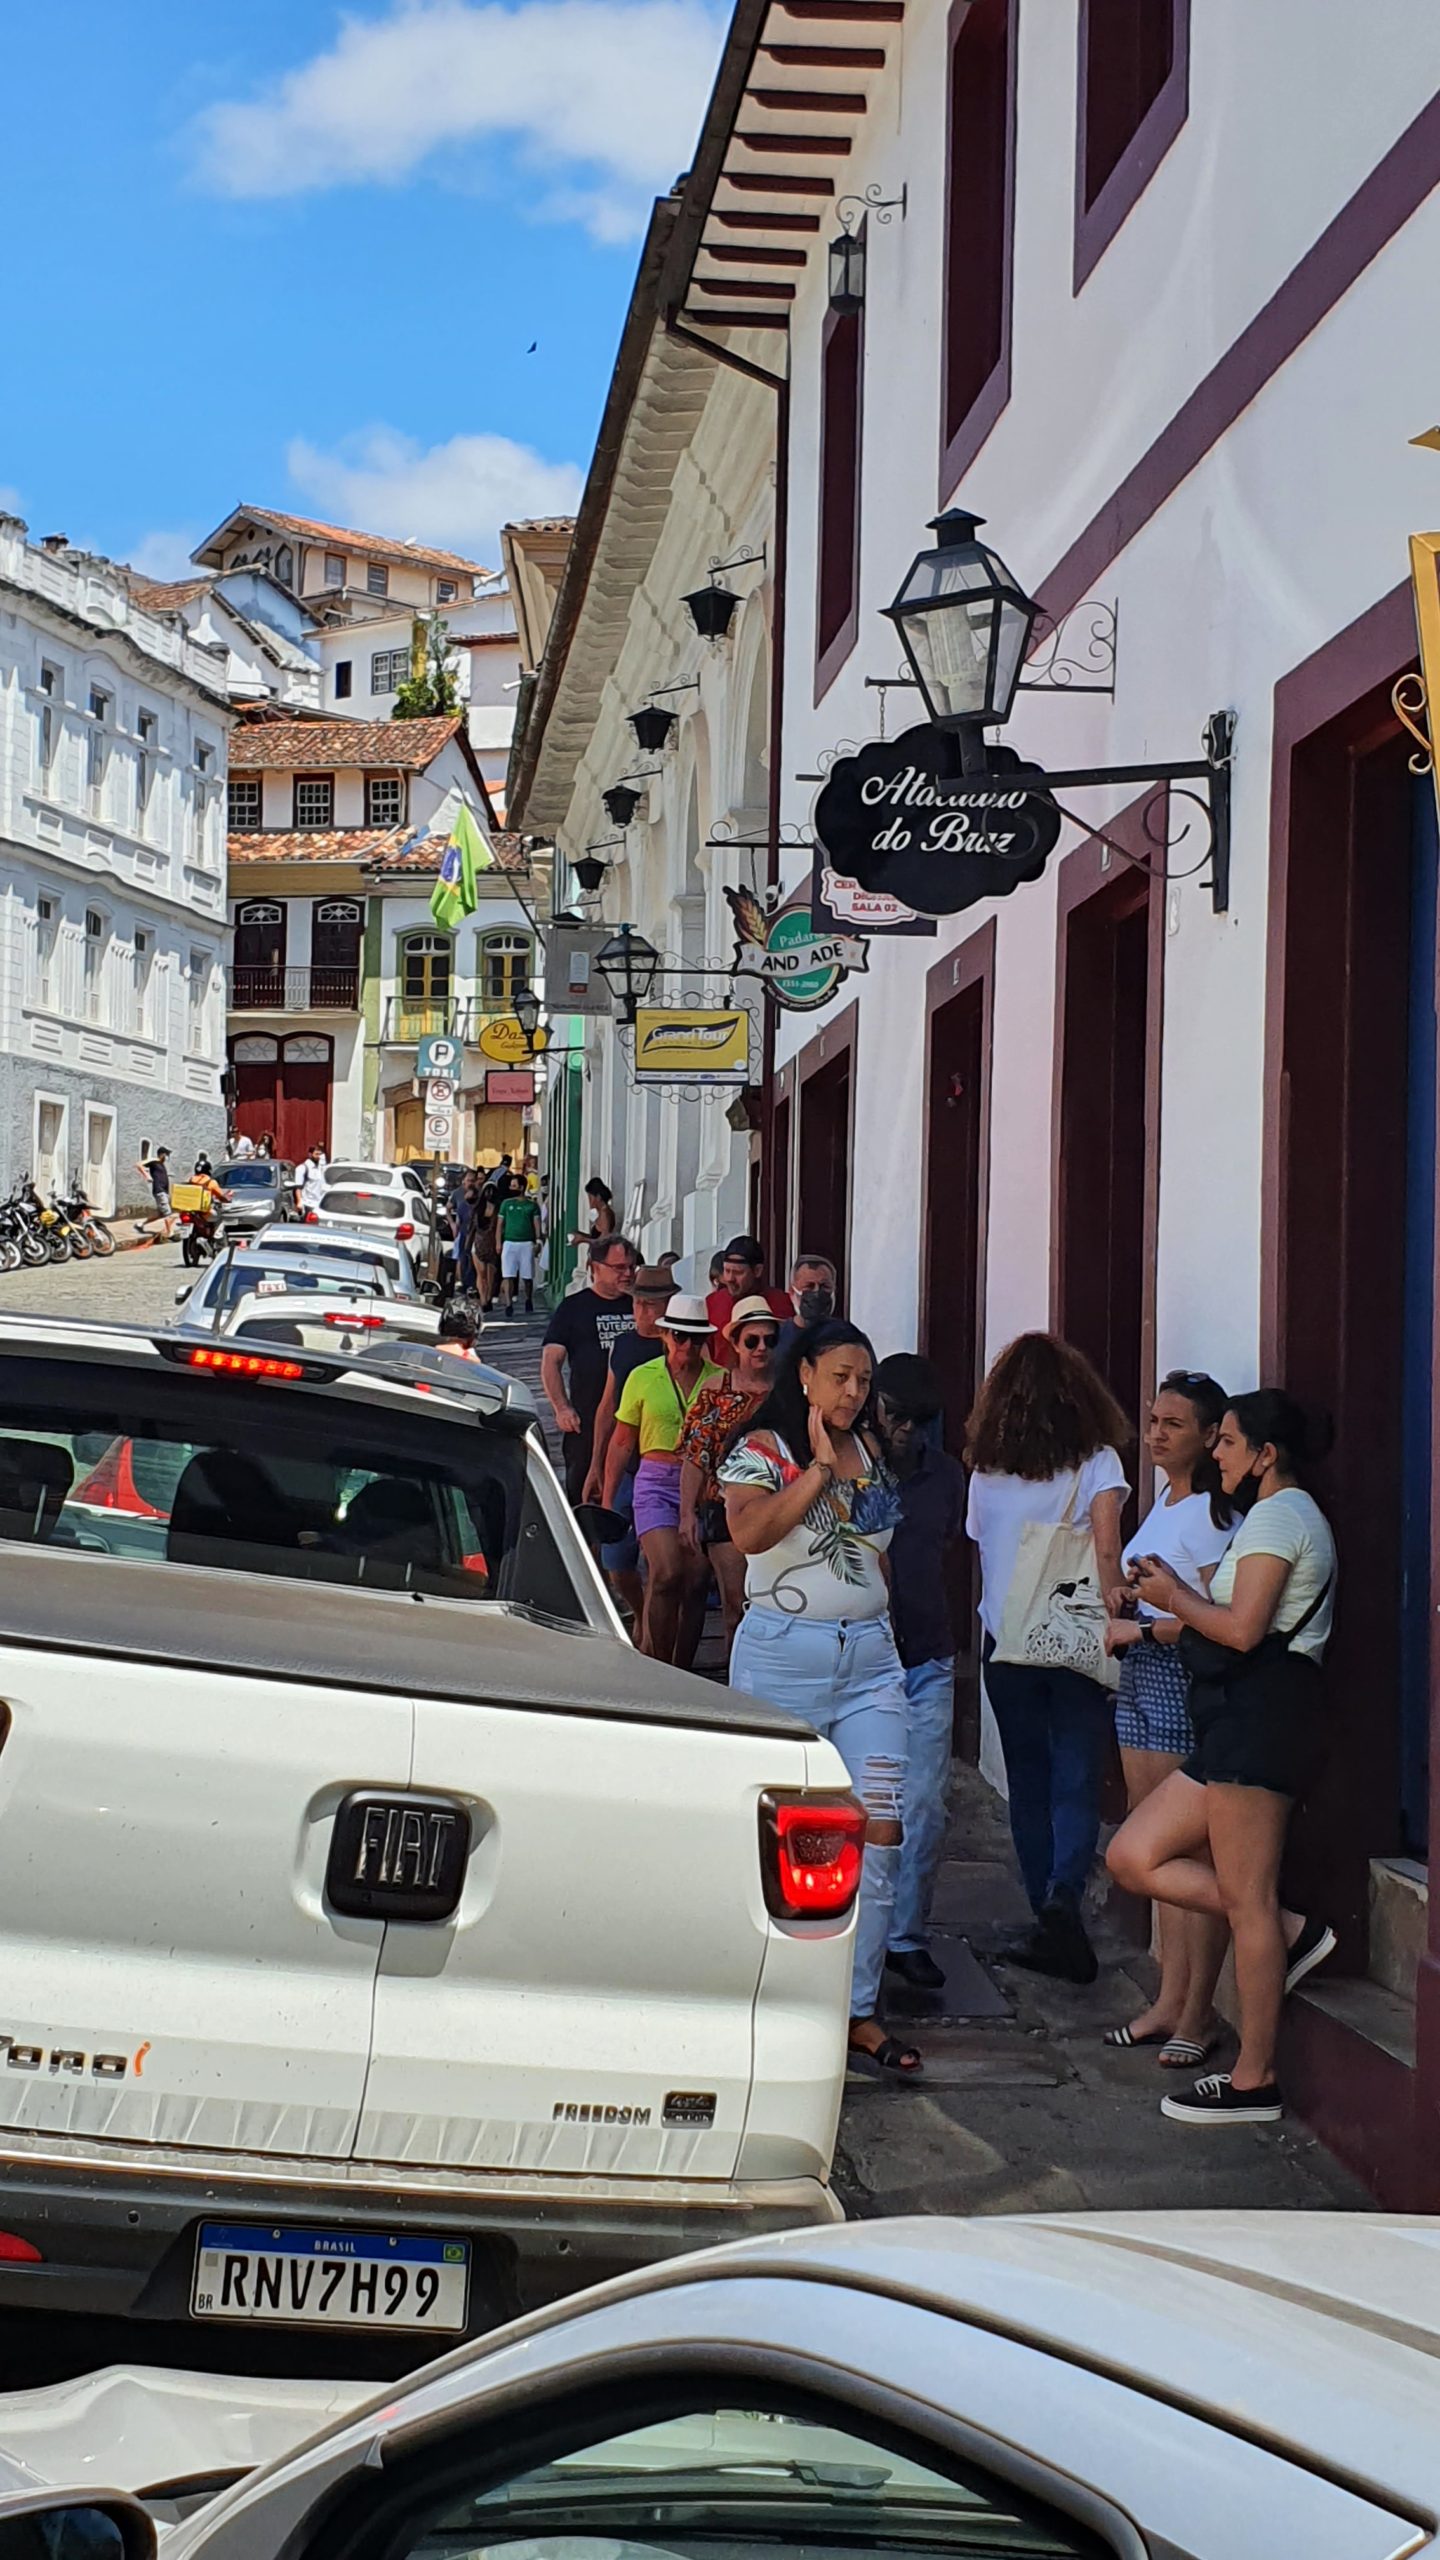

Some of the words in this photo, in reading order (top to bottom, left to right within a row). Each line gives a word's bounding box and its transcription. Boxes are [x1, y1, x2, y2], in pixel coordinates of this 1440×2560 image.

[871, 817, 912, 851] do
[920, 812, 1017, 854] Braz
[852, 902, 882, 912] SALA
[884, 903, 898, 913] 02
[434, 1043, 449, 1061] P
[423, 1066, 455, 1078] TAXI
[433, 1119, 443, 1132] E
[353, 1806, 456, 1887] FIAT
[551, 2102, 652, 2127] FREEDOM
[313, 2239, 357, 2254] BRASIL
[220, 2254, 440, 2318] RNV7H99
[197, 2293, 214, 2311] BR
